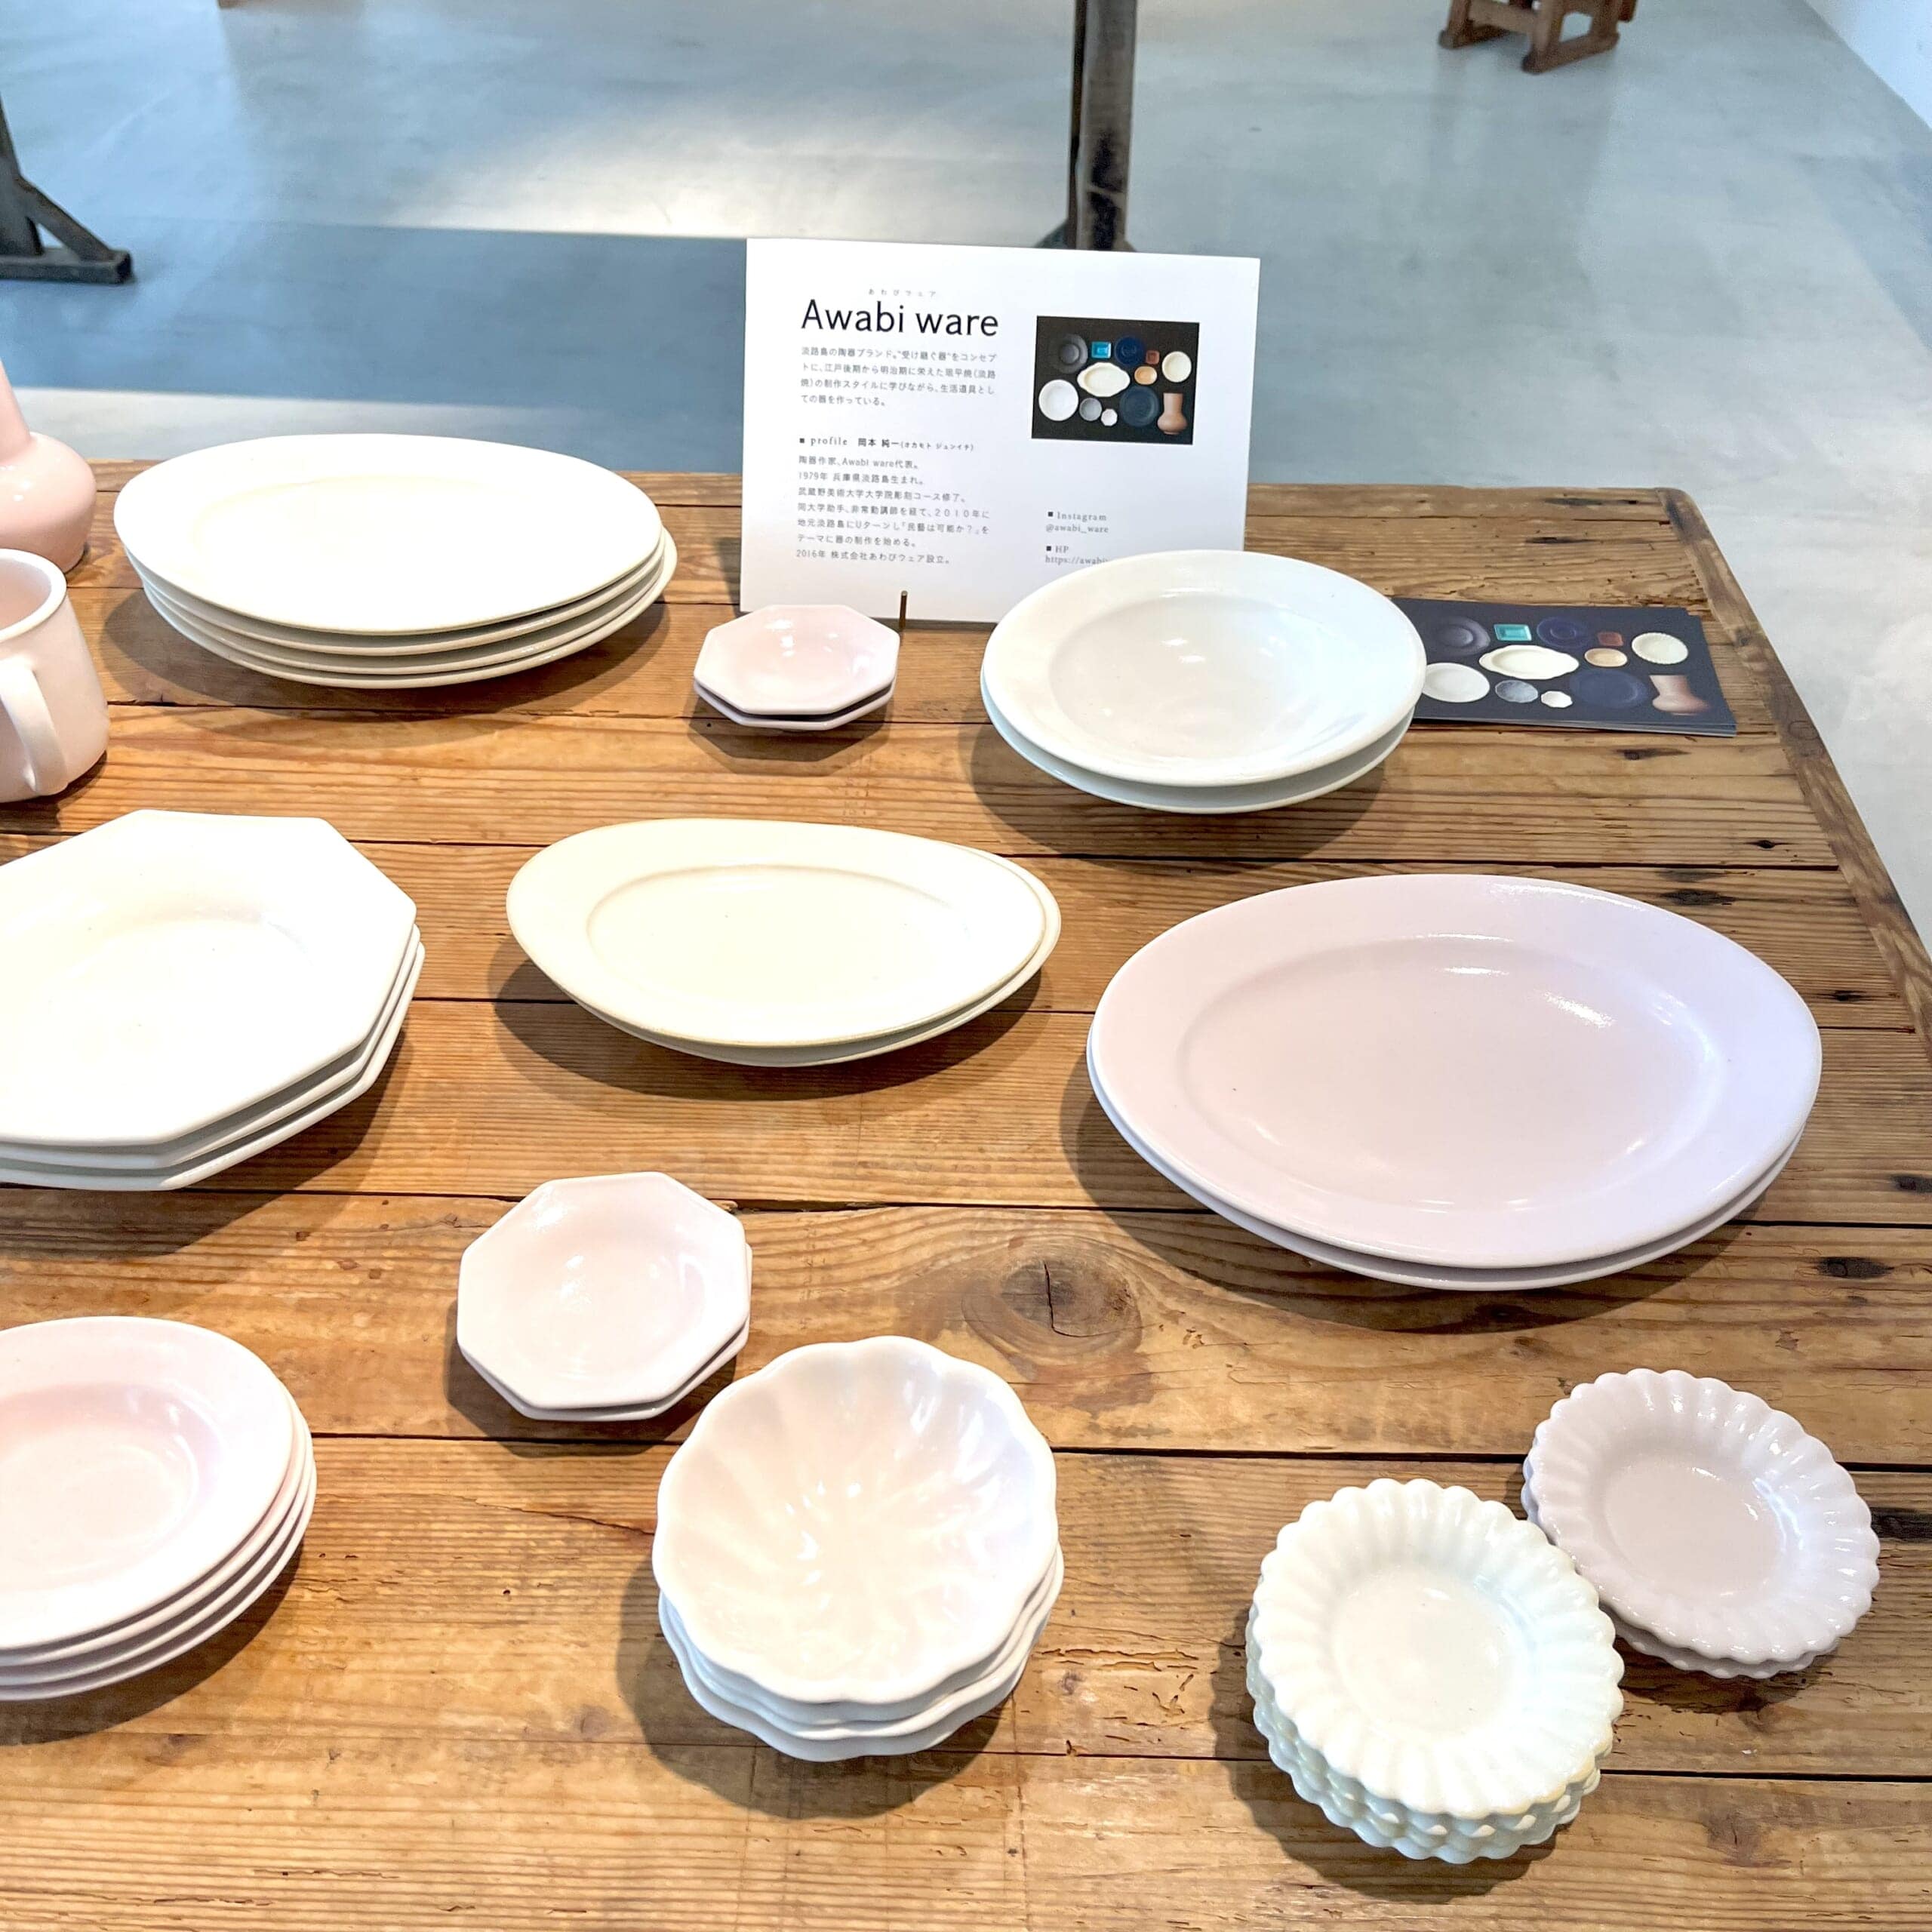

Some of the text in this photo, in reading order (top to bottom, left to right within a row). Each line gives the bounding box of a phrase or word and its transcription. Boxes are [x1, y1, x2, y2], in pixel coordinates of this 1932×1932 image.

[801, 299, 999, 337] Awabi ware
[811, 436, 848, 446] profile
[858, 438, 877, 448] 岡本
[798, 472, 828, 481] 1979年
[1057, 511, 1107, 522] Instagram
[1046, 524, 1109, 534] @awabi_ware
[796, 549, 826, 559] 2016年
